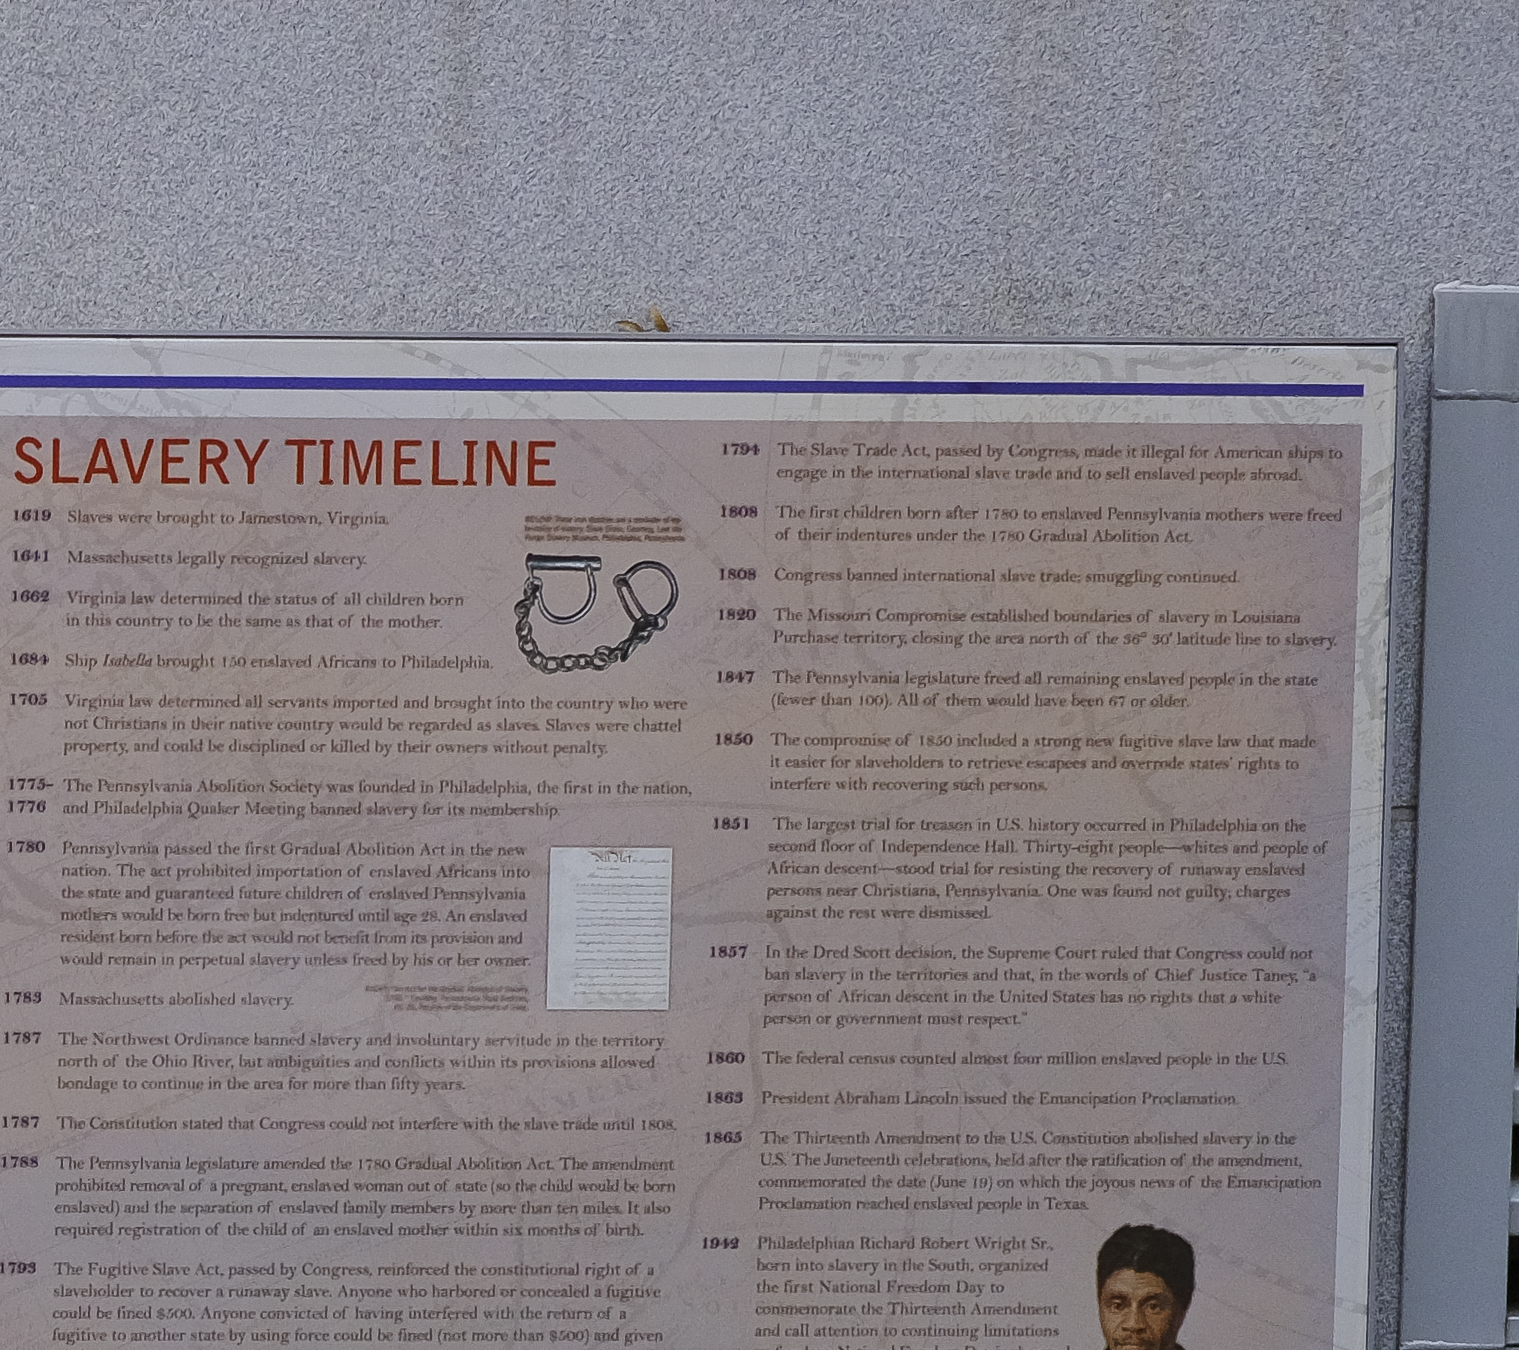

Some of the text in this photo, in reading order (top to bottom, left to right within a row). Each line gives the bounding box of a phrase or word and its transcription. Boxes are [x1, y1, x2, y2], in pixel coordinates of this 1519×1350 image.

[722, 441, 761, 456] 1794
[15, 436, 557, 488] SLAVERY TIMELINE
[13, 508, 390, 530] 1619 Slaves were brought to Jamestown, Virginia.
[719, 607, 757, 621] 1820
[10, 692, 48, 706] 1705
[7, 840, 46, 854] 1780
[3, 990, 294, 1011] 1783 Massachusetts abolished slavery.
[4, 1031, 42, 1045] 1787
[707, 1051, 746, 1065] 1860
[706, 1090, 744, 1105] 1863
[761, 1090, 830, 1106] President
[833, 1090, 900, 1106] Abraham
[904, 1090, 959, 1106] Lincoln
[963, 1090, 1008, 1106] issued
[1012, 1090, 1036, 1107] the
[1039, 1090, 1137, 1110] Emancipation
